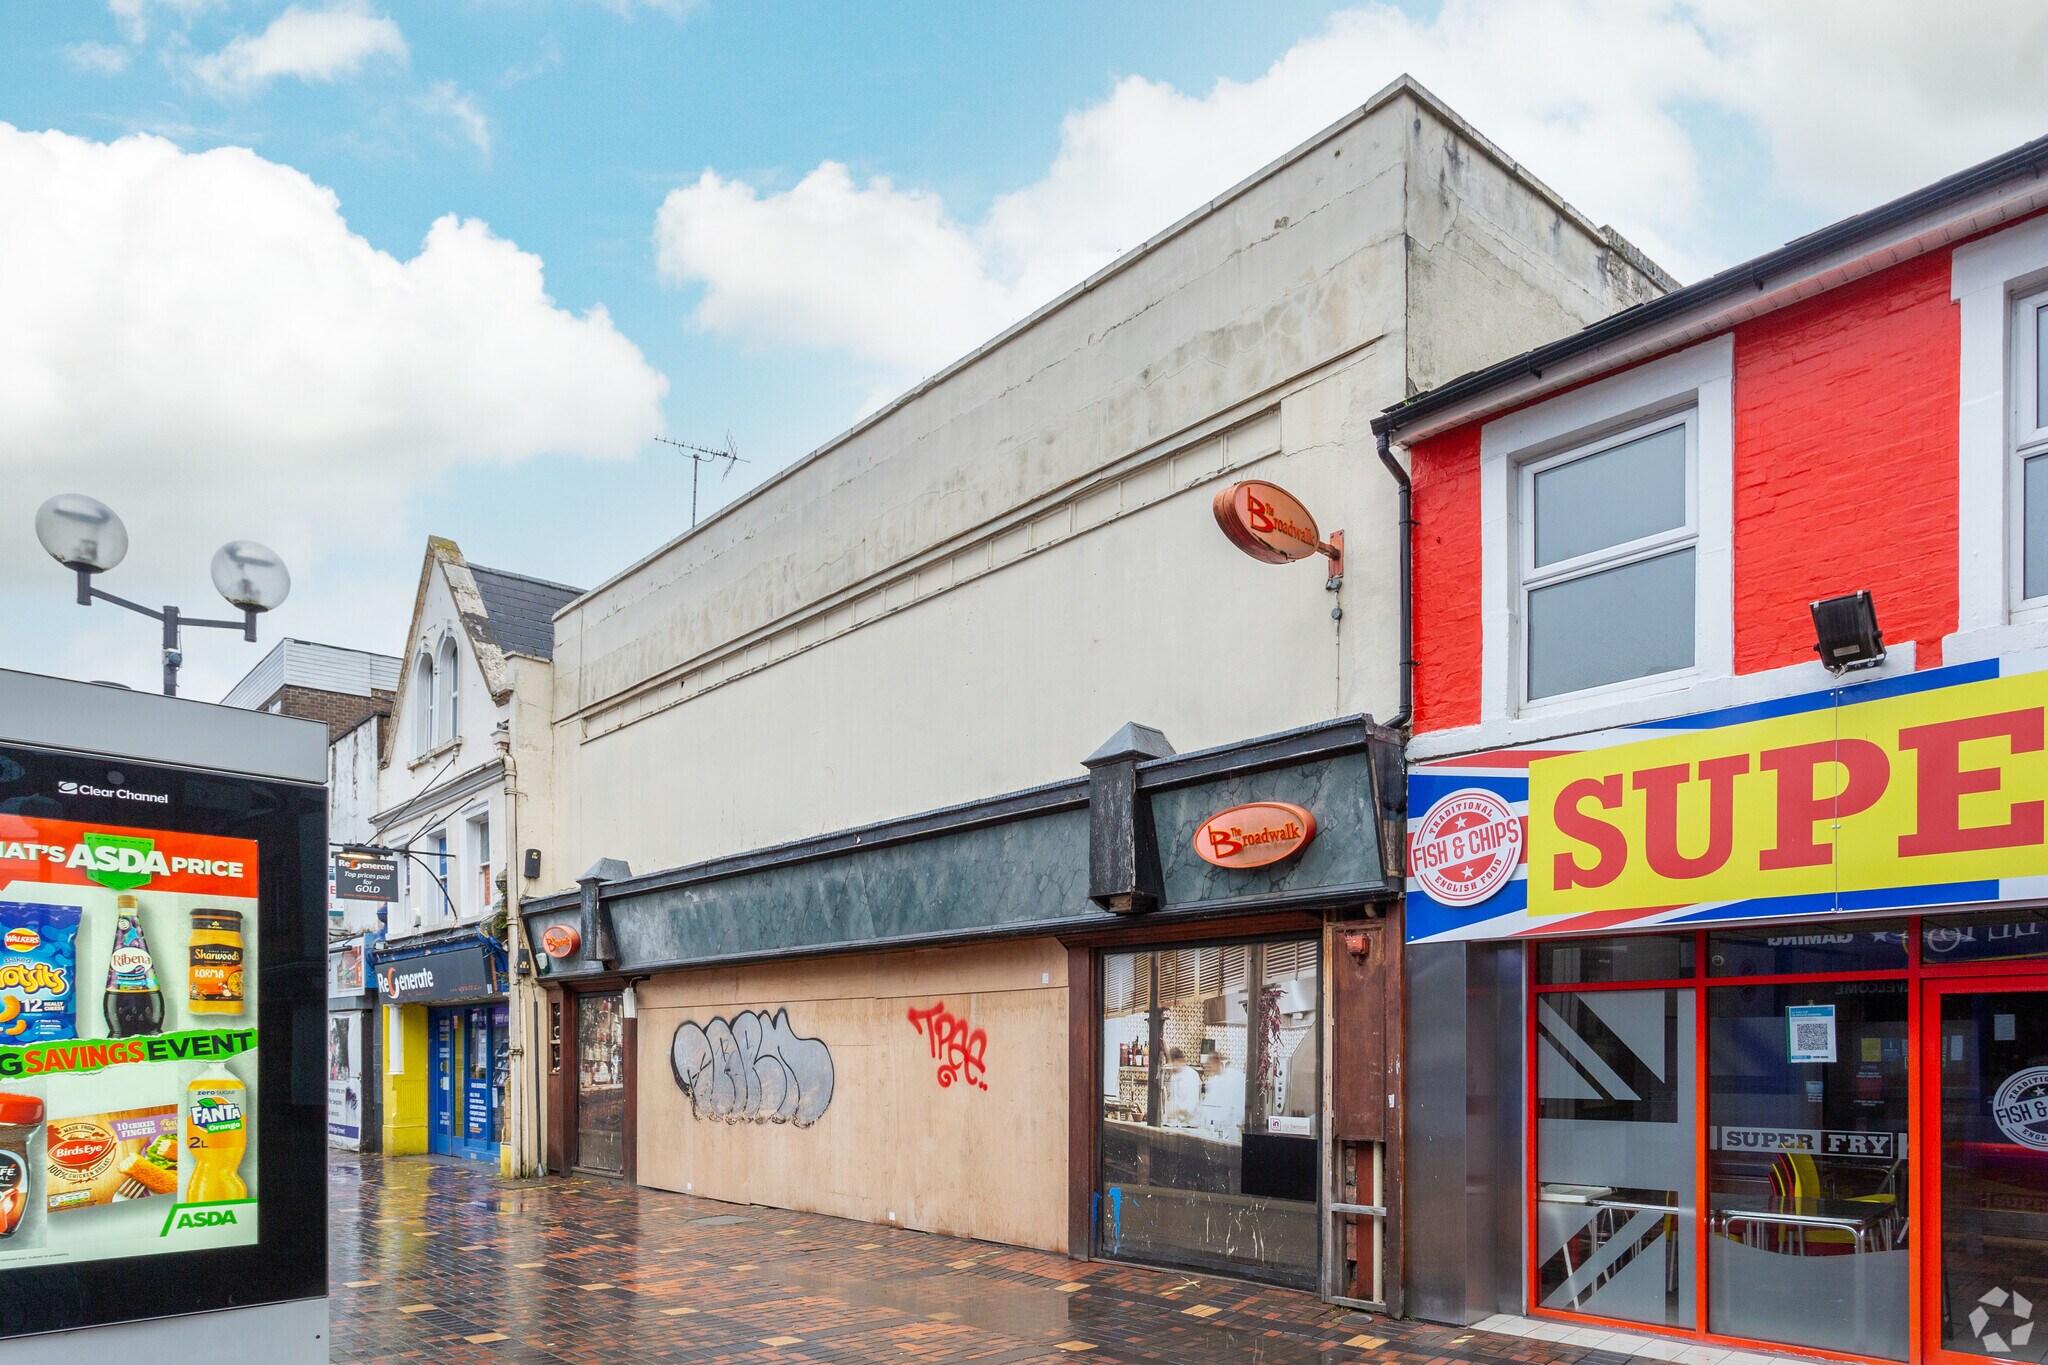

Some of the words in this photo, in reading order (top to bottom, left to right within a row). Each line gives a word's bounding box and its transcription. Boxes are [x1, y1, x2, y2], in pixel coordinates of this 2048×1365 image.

[79, 784, 115, 798] Clear
[116, 789, 169, 804] Channel
[1429, 801, 1494, 836] TRADITIONAL
[1207, 822, 1301, 859] Broadwalk
[1230, 826, 1242, 837] The
[1412, 840, 1449, 872] FISH
[1452, 836, 1466, 860] &
[1468, 818, 1519, 855] CHIPS
[65, 843, 171, 877] ASDA
[171, 856, 244, 878] PRICE
[1434, 875, 1478, 893] ENGLISH
[1481, 858, 1502, 884] FOOD
[355, 885, 381, 893] GOLD
[6, 935, 39, 944] WALKERS
[5, 956, 32, 964] Baked
[113, 953, 151, 967] Ribena
[194, 969, 224, 979] KORMA
[21, 999, 43, 1012] 12
[25, 1041, 146, 1074] SAVINGS
[146, 1032, 253, 1061] EVENT
[191, 1104, 242, 1125] FANTA
[1995, 1103, 2033, 1127] FISH
[2033, 1101, 2048, 1117] &
[116, 1122, 128, 1131] 10
[121, 1127, 157, 1138] FINGERS
[1726, 1130, 1815, 1150] SUPER
[1828, 1133, 1889, 1154] FRY
[47, 1164, 68, 1180] 100%
[68, 1171, 95, 1179] CHICKEN
[176, 1210, 237, 1229] ASDA
